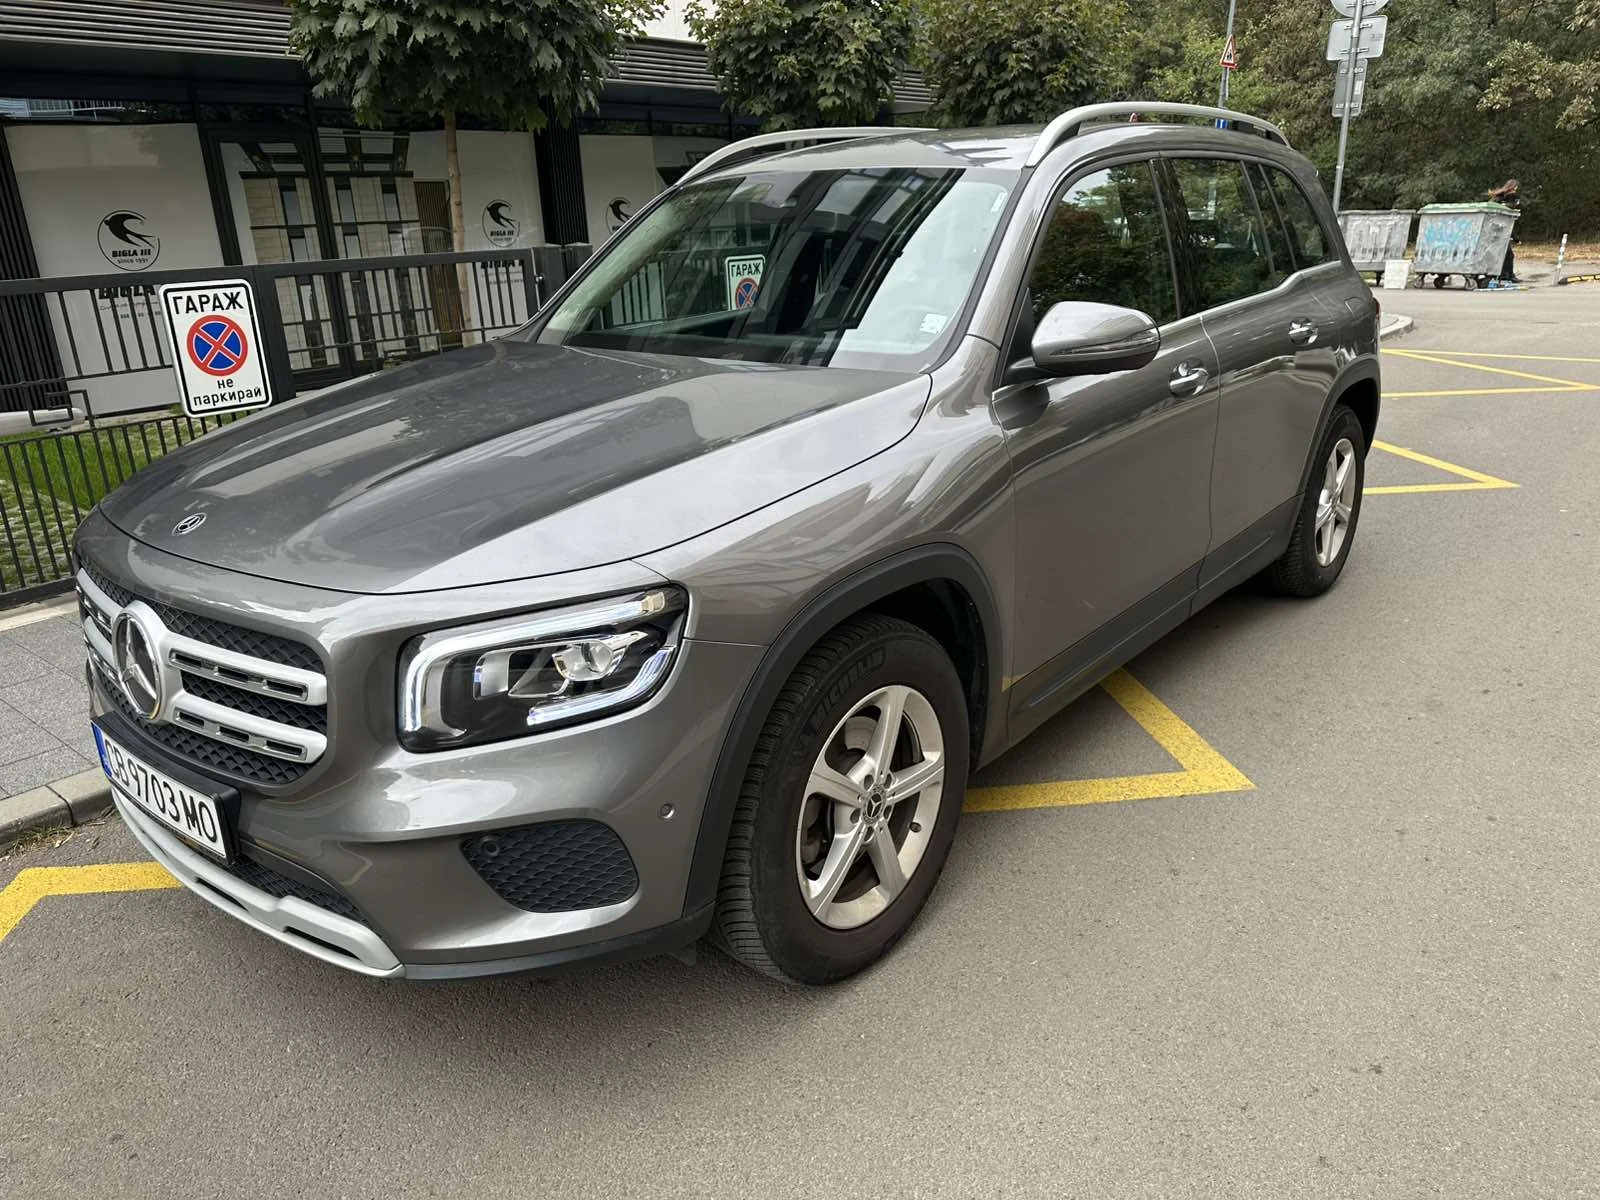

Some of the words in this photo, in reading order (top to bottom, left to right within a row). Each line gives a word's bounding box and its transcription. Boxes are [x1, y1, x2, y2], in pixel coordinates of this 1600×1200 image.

[112, 249, 138, 257] BIGLA
[731, 263, 761, 277] ГАРАЖ
[172, 291, 244, 314] ГАРАЖ
[217, 378, 234, 389] не
[193, 386, 262, 406] паркирай
